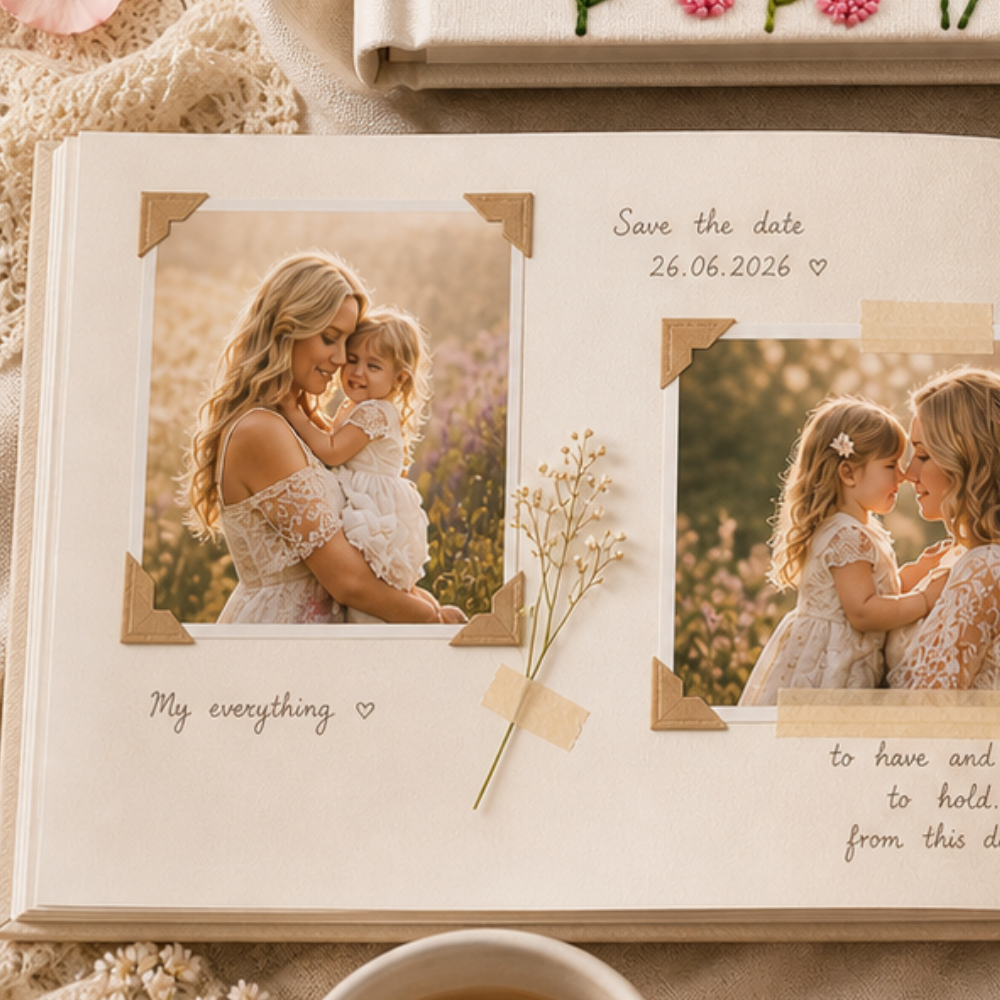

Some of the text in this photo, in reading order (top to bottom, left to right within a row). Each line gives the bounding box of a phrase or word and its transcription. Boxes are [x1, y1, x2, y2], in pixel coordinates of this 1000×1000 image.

[613, 207, 805, 236] Save the date
[649, 254, 792, 277] 26.06.2026
[150, 690, 335, 736] My everything
[829, 741, 996, 768] to have and
[886, 785, 912, 810] to
[844, 824, 904, 863] from
[922, 822, 966, 849] this
